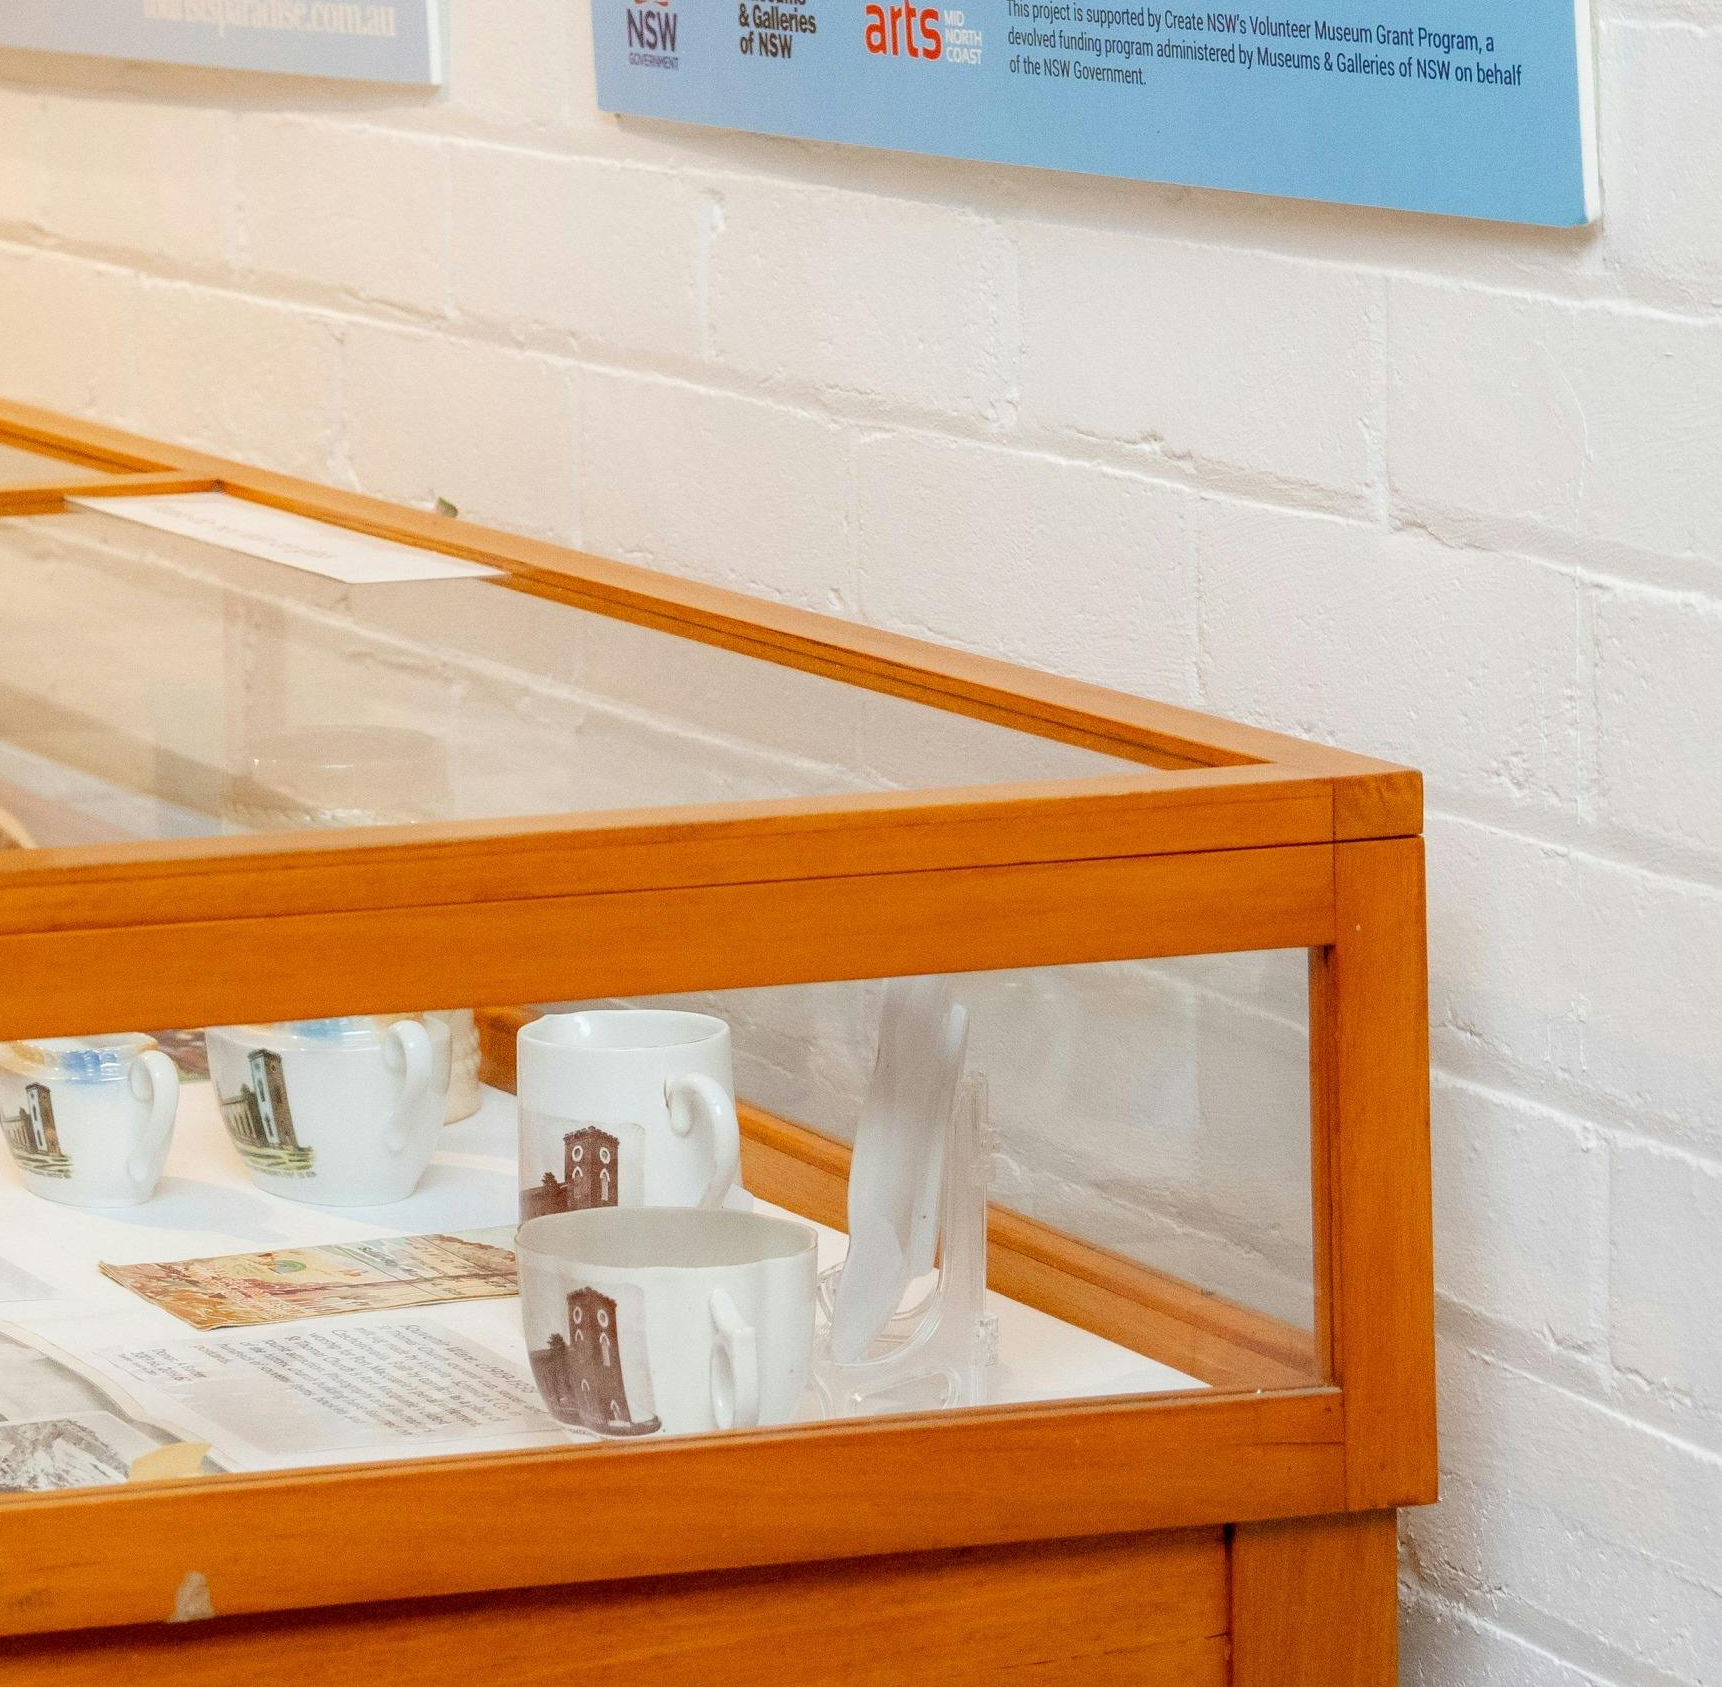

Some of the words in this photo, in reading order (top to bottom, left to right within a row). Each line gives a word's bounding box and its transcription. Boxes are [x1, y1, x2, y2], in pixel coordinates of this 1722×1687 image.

[627, 8, 677, 52] NSW
[739, 4, 749, 26] &
[752, 6, 817, 34] Galleries
[943, 10, 965, 27] MID
[1032, 4, 1070, 24] project
[1074, 3, 1083, 22] is
[1087, 7, 1144, 28] supported
[1147, 8, 1161, 32] by
[1165, 10, 1203, 31] Create
[1249, 15, 1311, 39] Volunteer
[1314, 20, 1372, 43] Museum
[1376, 25, 1414, 46] Grant
[1418, 27, 1482, 55] Program,
[1486, 37, 1494, 52] a
[740, 32, 754, 56] of
[758, 33, 793, 59] NSW
[945, 27, 982, 46] NORTH
[629, 52, 679, 71] GOVERNMENT
[945, 46, 982, 65] COAST
[1008, 27, 1056, 49] devolved
[1059, 30, 1102, 57] funding
[1105, 39, 1153, 60] program
[1157, 39, 1235, 63] administered
[1239, 44, 1253, 69] by
[1257, 47, 1320, 71] Museums
[1324, 51, 1333, 72] &
[1337, 52, 1395, 77] Galleries
[1399, 56, 1412, 78] of
[1417, 59, 1450, 80] NSW
[1455, 66, 1473, 82] on
[1476, 62, 1521, 86] behalf
[1010, 56, 1020, 73] of
[1023, 56, 1041, 75] the
[1044, 58, 1070, 77] NSW
[1073, 61, 1146, 85] Government.
